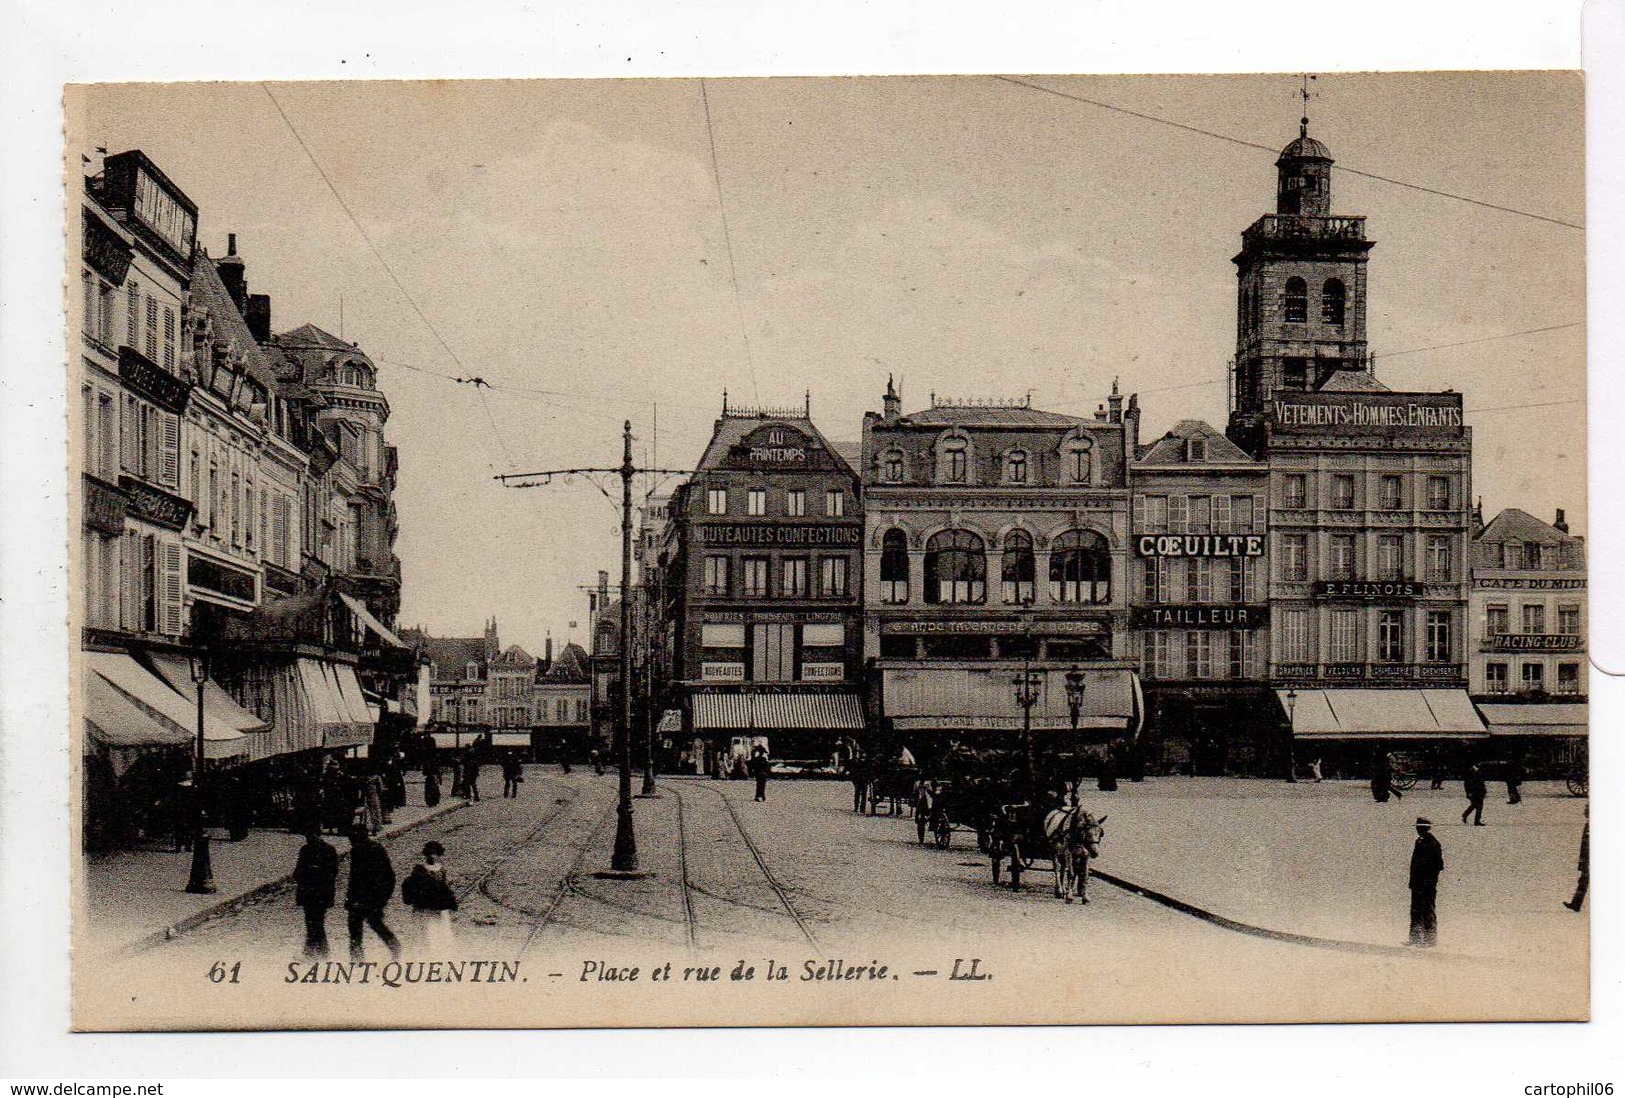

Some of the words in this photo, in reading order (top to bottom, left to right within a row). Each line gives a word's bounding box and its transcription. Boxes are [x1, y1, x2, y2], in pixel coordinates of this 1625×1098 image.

[1275, 401, 1347, 425] VETEMENTS
[1353, 403, 1403, 426] HOMMES
[1408, 404, 1461, 427] ENFANTS
[769, 432, 784, 445] AU
[750, 447, 806, 461] PRINTEMPS
[777, 528, 860, 542] CONFECTIONS
[1342, 584, 1413, 594] FLINOIS
[1529, 579, 1547, 589] DU
[1552, 579, 1588, 589] MIDI
[1152, 609, 1248, 623] TAILLEUR
